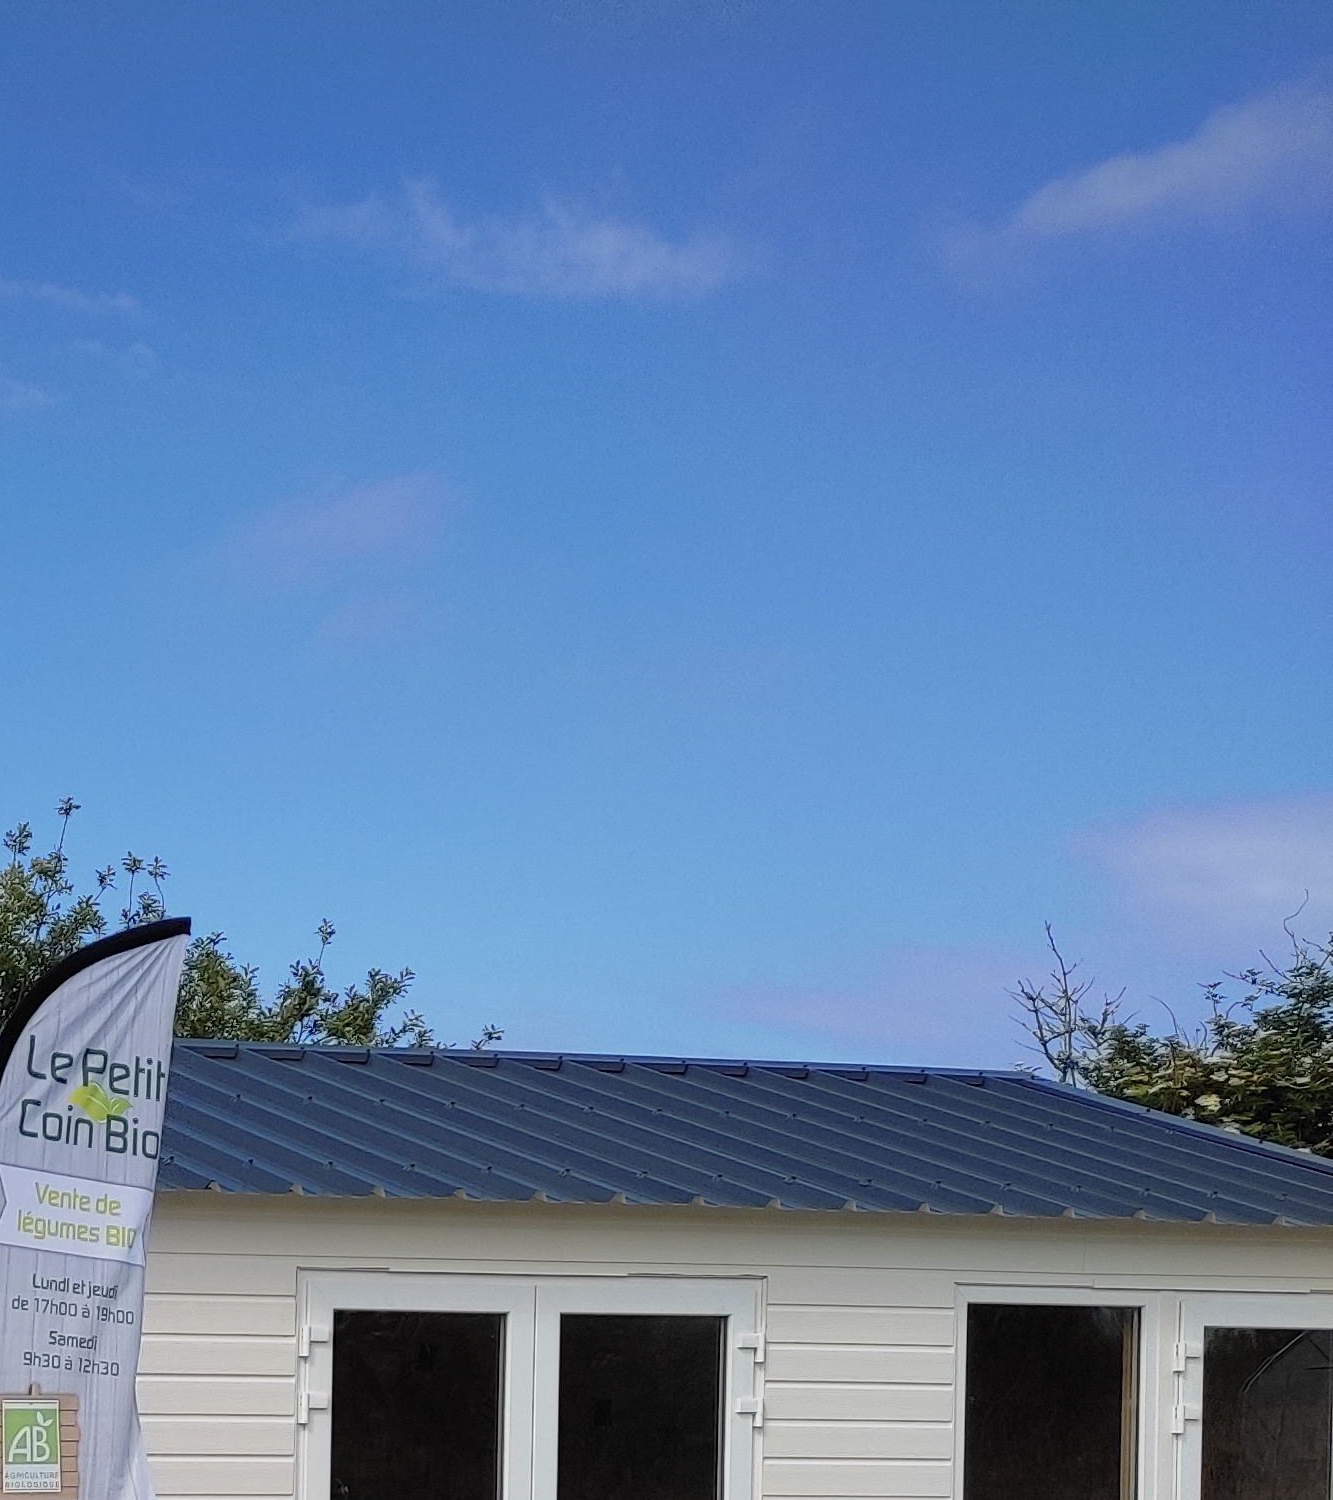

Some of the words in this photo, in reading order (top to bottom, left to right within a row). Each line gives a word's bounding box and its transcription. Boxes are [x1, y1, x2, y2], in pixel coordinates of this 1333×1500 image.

[26, 1035, 73, 1084] Le
[83, 1048, 166, 1101] Petit
[19, 1098, 94, 1149] Coin
[105, 1114, 160, 1160] Bio
[34, 1181, 91, 1213] Vente
[95, 1193, 121, 1216] de
[16, 1210, 100, 1243] légumes
[32, 1273, 70, 1293] Lundi
[72, 1280, 86, 1295] et
[87, 1281, 119, 1300] jeudi
[11, 1295, 29, 1311] de
[34, 1297, 78, 1317] 17h00
[81, 1304, 90, 1319] à
[96, 1305, 135, 1325] 19h00
[48, 1331, 98, 1351] Samedi
[23, 1351, 61, 1369] 9h30
[64, 1356, 73, 1371] à
[78, 1357, 120, 1377] 12h30
[7, 1425, 51, 1463] AB
[4, 1471, 59, 1480] AGRICULTURE
